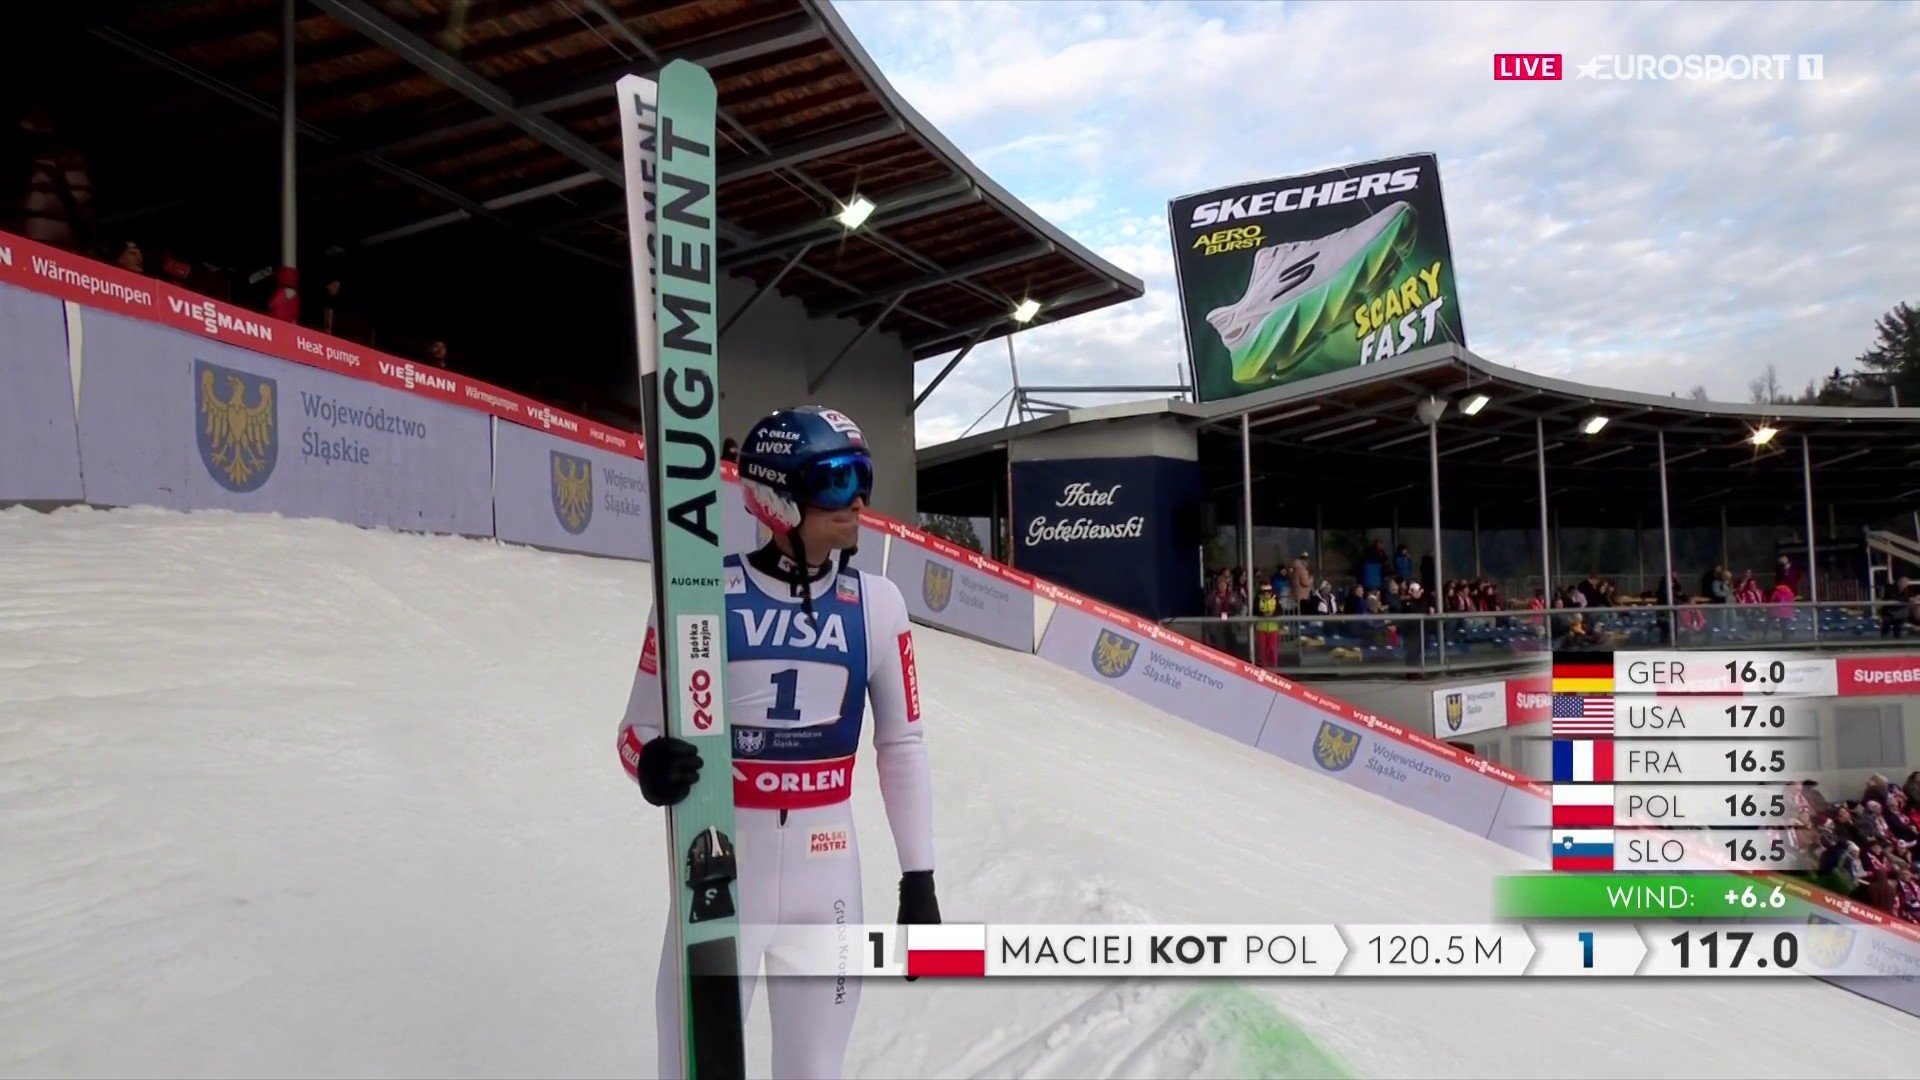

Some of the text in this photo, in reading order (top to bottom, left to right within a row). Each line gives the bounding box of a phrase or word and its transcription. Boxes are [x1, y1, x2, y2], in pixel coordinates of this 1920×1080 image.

[1190, 167, 1421, 228] SKECHERS
[1193, 225, 1262, 249] AERO
[1204, 236, 1268, 256] BURST
[32, 255, 151, 306] Wärmepumpen
[1354, 261, 1442, 338] SCARY
[168, 296, 273, 342] VIESSMANN
[661, 116, 719, 547] AUGMENT
[1359, 296, 1445, 366] FAST
[297, 336, 360, 367] Heat pumps
[379, 361, 456, 393] VIESSMANN
[465, 384, 519, 412] Wärmepumpen
[301, 391, 427, 439] Województwo
[527, 405, 578, 433] VIESSMANN
[589, 428, 605, 440] Heat
[605, 432, 626, 448] pumps
[756, 441, 793, 455] uvex
[768, 428, 800, 440] ORLEN
[302, 431, 370, 466] Śląskie
[604, 467, 647, 494] Wojewó
[748, 463, 788, 485] uvex
[604, 496, 640, 517] Śląskie
[1056, 482, 1122, 507] Hotel
[1025, 516, 1145, 547] Gołębiewski
[671, 576, 720, 587] AUGMENT
[1036, 581, 1084, 605] VIESSMANN
[690, 623, 699, 659] Spółka
[701, 619, 711, 659] Akcyjna
[732, 609, 848, 653] VISA
[1137, 621, 1185, 647] VIESSMANN
[1142, 665, 1183, 691] Śląskie
[1150, 650, 1225, 690] Województwo
[1244, 665, 1293, 691] VIESSMANN
[1854, 669, 1920, 685] SUPERBE
[766, 669, 801, 721] 1
[906, 664, 920, 717] ORLEN
[1353, 710, 1403, 736] VIESSMANN
[1365, 758, 1407, 783] Śląskie
[1373, 742, 1451, 783] Województwo
[755, 768, 846, 793] ORLEN
[811, 831, 847, 843] POLSKI
[811, 840, 847, 852] MISTRZ
[1824, 895, 1883, 923] VIESSMANN
